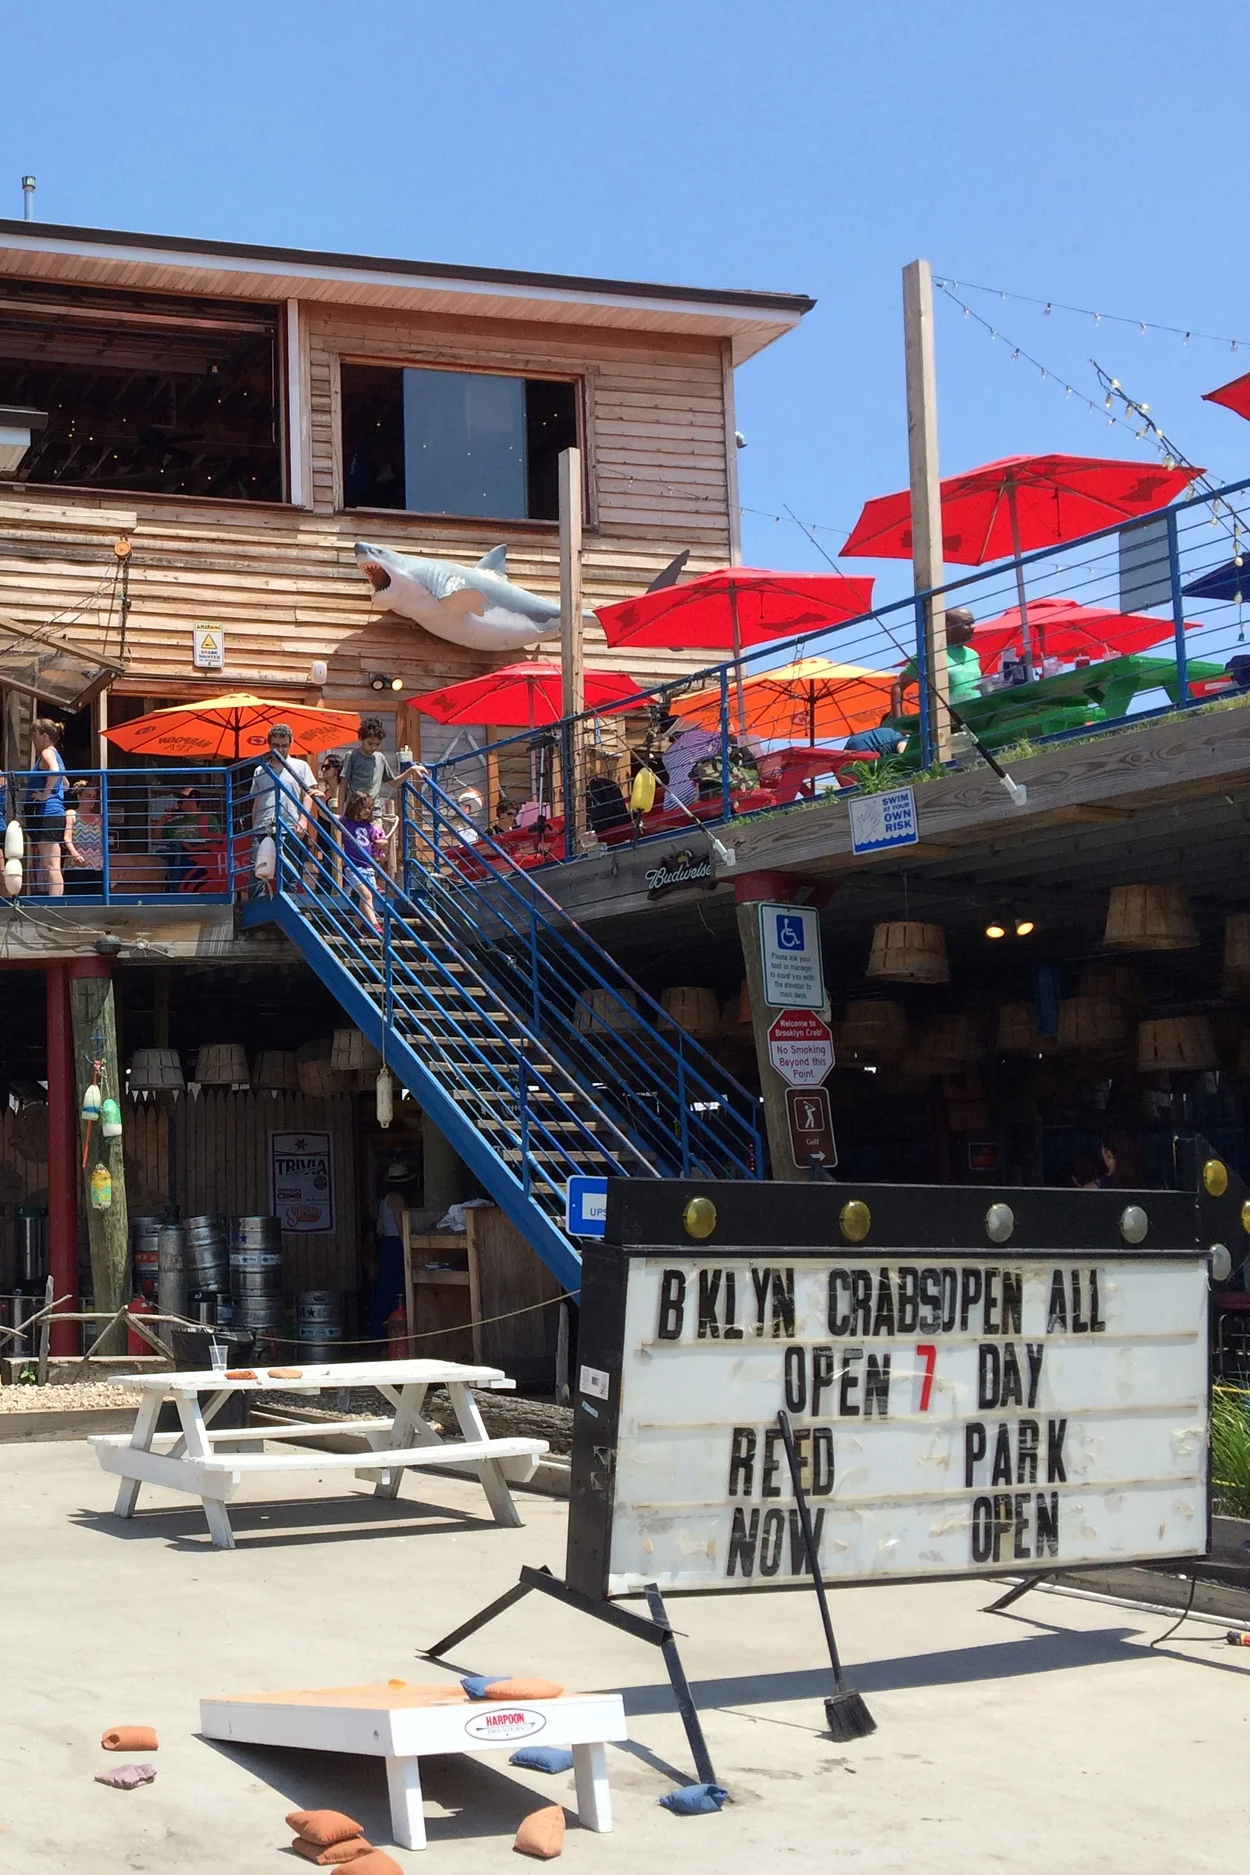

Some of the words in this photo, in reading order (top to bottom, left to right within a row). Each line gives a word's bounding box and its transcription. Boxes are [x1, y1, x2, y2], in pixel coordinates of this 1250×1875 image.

[882, 793, 909, 806] SWIM
[892, 802, 910, 811] YOUR
[884, 808, 911, 823] OWN
[885, 819, 912, 833] RISK
[771, 952, 788, 961] Please
[789, 954, 798, 962] ask
[800, 956, 812, 964] your
[771, 961, 783, 970] host
[791, 964, 813, 973] manager
[777, 971, 791, 979] assist
[792, 973, 802, 981] you
[803, 972, 815, 981] with
[774, 980, 783, 988] the
[784, 981, 805, 990] elevator
[775, 1029, 804, 1038] Brooklyn
[805, 1029, 823, 1037] Crab!
[777, 1045, 788, 1055] No
[790, 1045, 826, 1056] Smoking
[779, 1057, 810, 1068] Beyond
[812, 1057, 826, 1066] this
[806, 1138, 820, 1146] Golf
[275, 1159, 328, 1176] TRIVIA
[1047, 1268, 1106, 1334] ALL
[785, 1346, 891, 1416] OPEN
[916, 1345, 937, 1411] 7
[979, 1342, 1044, 1410] DAY
[728, 1426, 834, 1498] REED
[966, 1418, 1067, 1488] PARK
[727, 1507, 826, 1577] NOW
[972, 1491, 1059, 1564] OPEN
[485, 1713, 525, 1727] HARPOON
[487, 1727, 525, 1735] BREWERY
